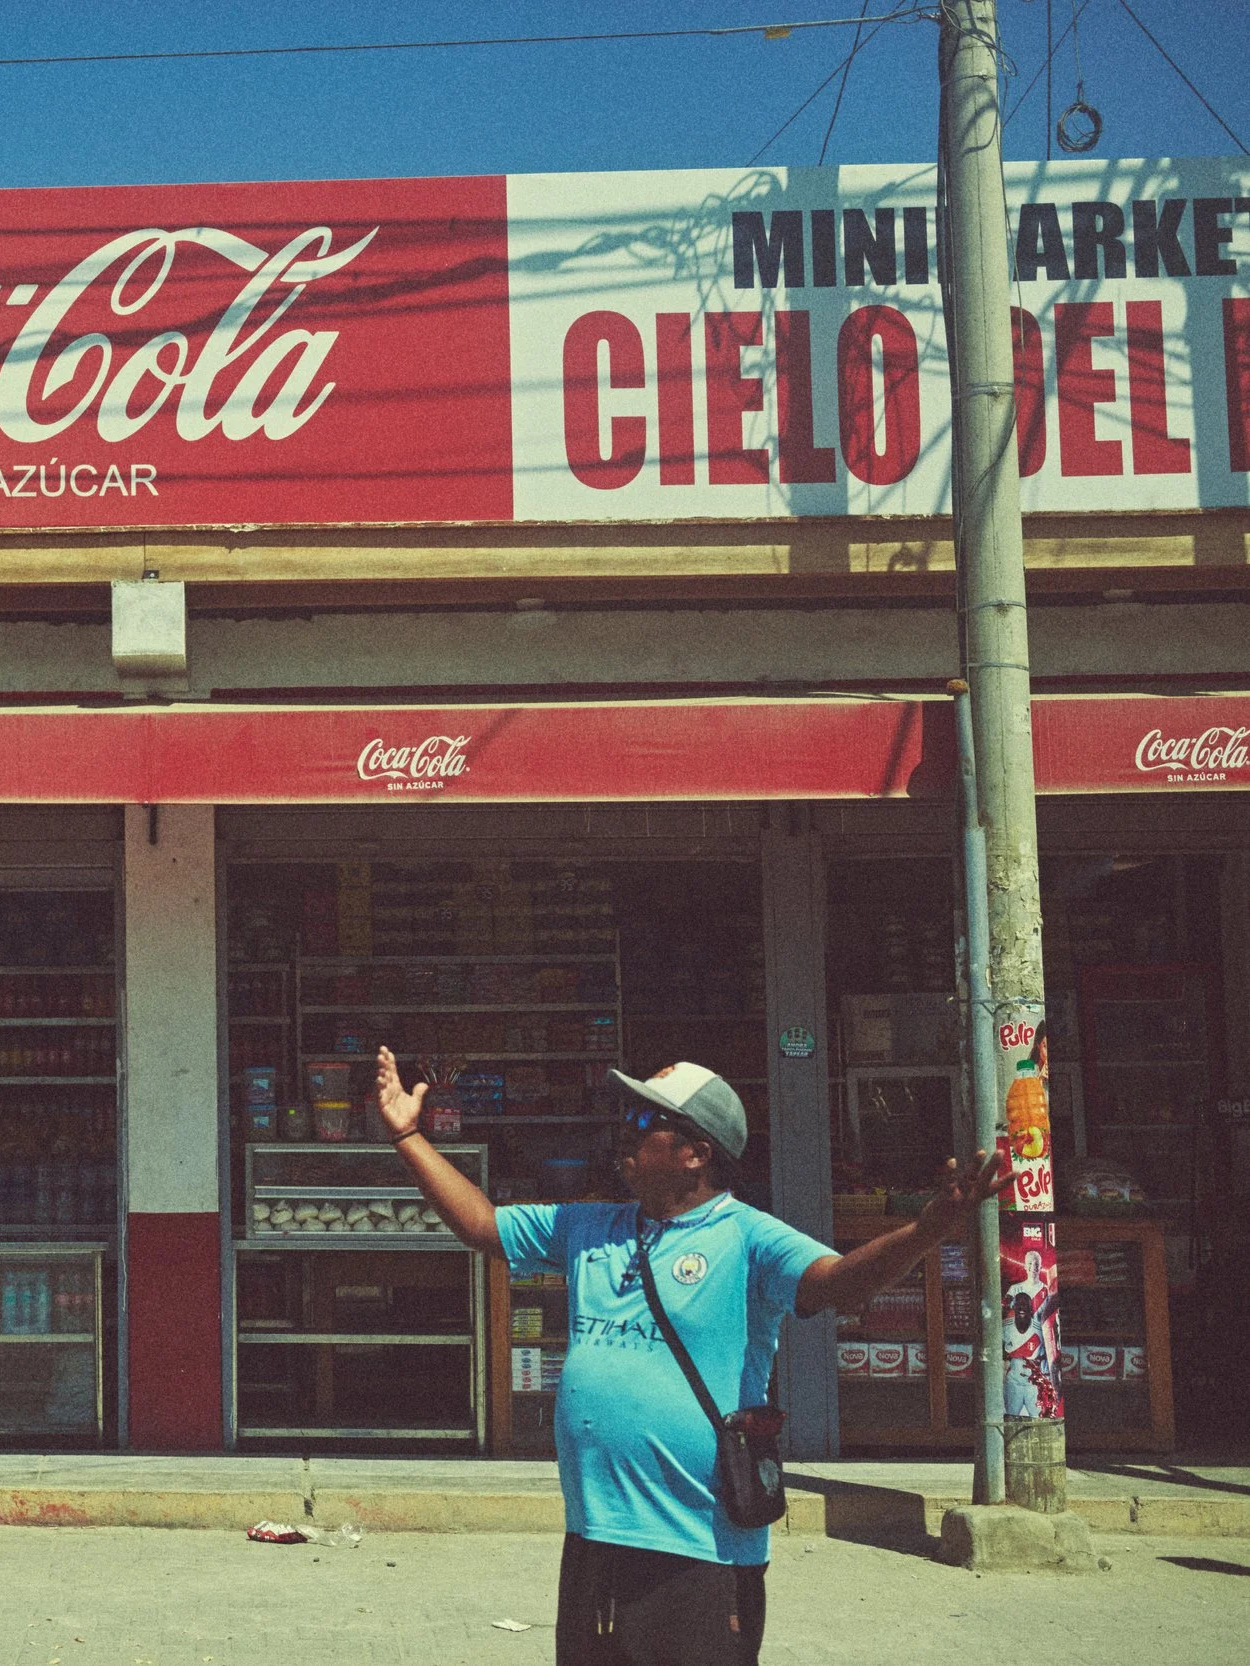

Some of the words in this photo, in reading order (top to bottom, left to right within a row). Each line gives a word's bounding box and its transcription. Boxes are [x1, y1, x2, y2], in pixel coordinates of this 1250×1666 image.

[732, 197, 1250, 289] MINIARKE
[562, 304, 922, 491] CIELO
[1135, 726, 1250, 771] Coca-Cola
[357, 735, 472, 780] Coca-Cola
[1167, 774, 1184, 783] SIN
[1186, 772, 1227, 782] AZÚCAR
[387, 782, 403, 791] SIN
[405, 780, 444, 789] AZÚCAR
[1023, 1227, 1042, 1238] BIG
[843, 1351, 865, 1361] Nova
[878, 1352, 899, 1361] Nova
[946, 1354, 967, 1364] Nova
[1089, 1354, 1110, 1363] Nova
